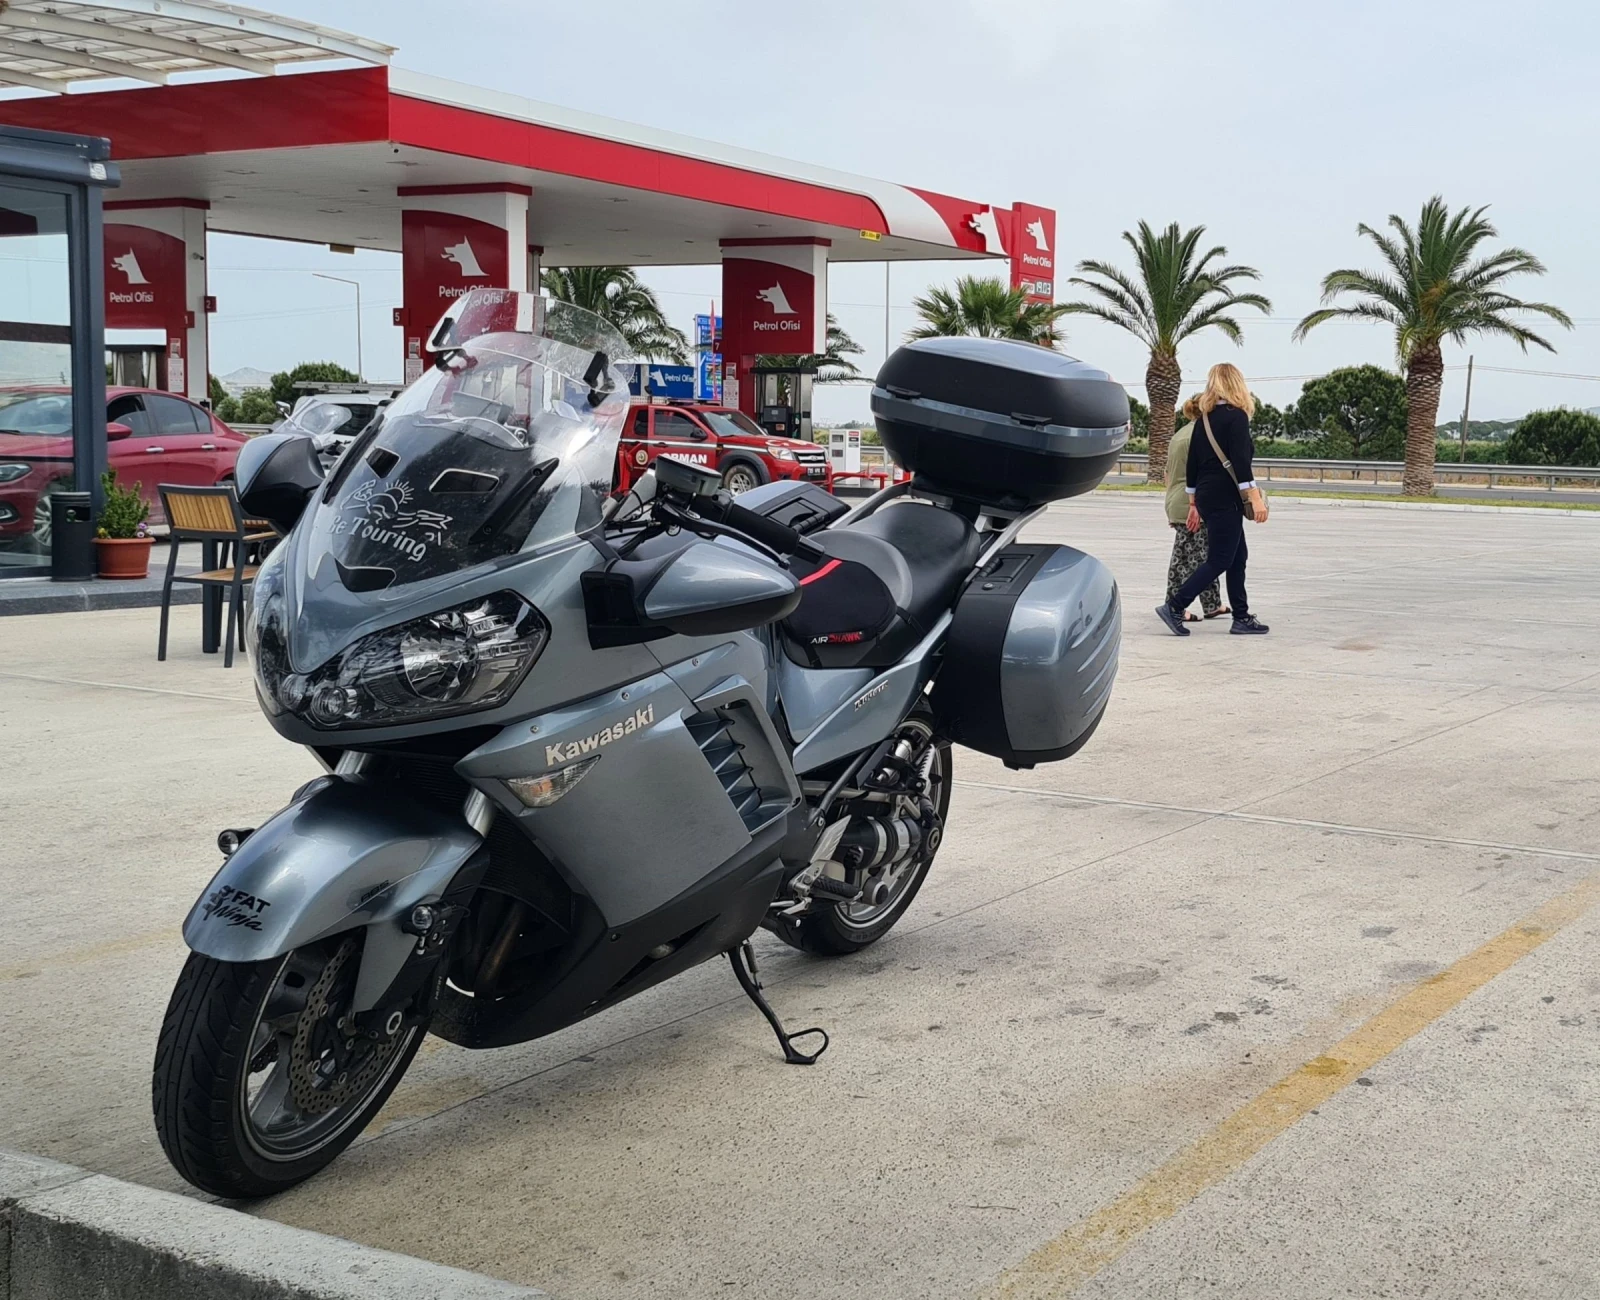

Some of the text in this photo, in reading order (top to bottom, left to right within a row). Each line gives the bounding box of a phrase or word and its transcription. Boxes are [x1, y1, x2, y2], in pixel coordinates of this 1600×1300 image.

[1023, 253, 1038, 265] Petrol
[109, 291, 154, 303] Petrol Ofisi
[439, 286, 466, 298] Petrol
[206, 300, 211, 309] 2
[394, 312, 400, 322] 5
[753, 320, 801, 331] Petrol Ofisi
[715, 342, 720, 351] 7
[665, 373, 681, 382] Petrol
[348, 517, 427, 562] Touring
[545, 703, 655, 767] Kawasaki
[231, 891, 271, 914] FAT
[212, 905, 263, 931] Ninja
